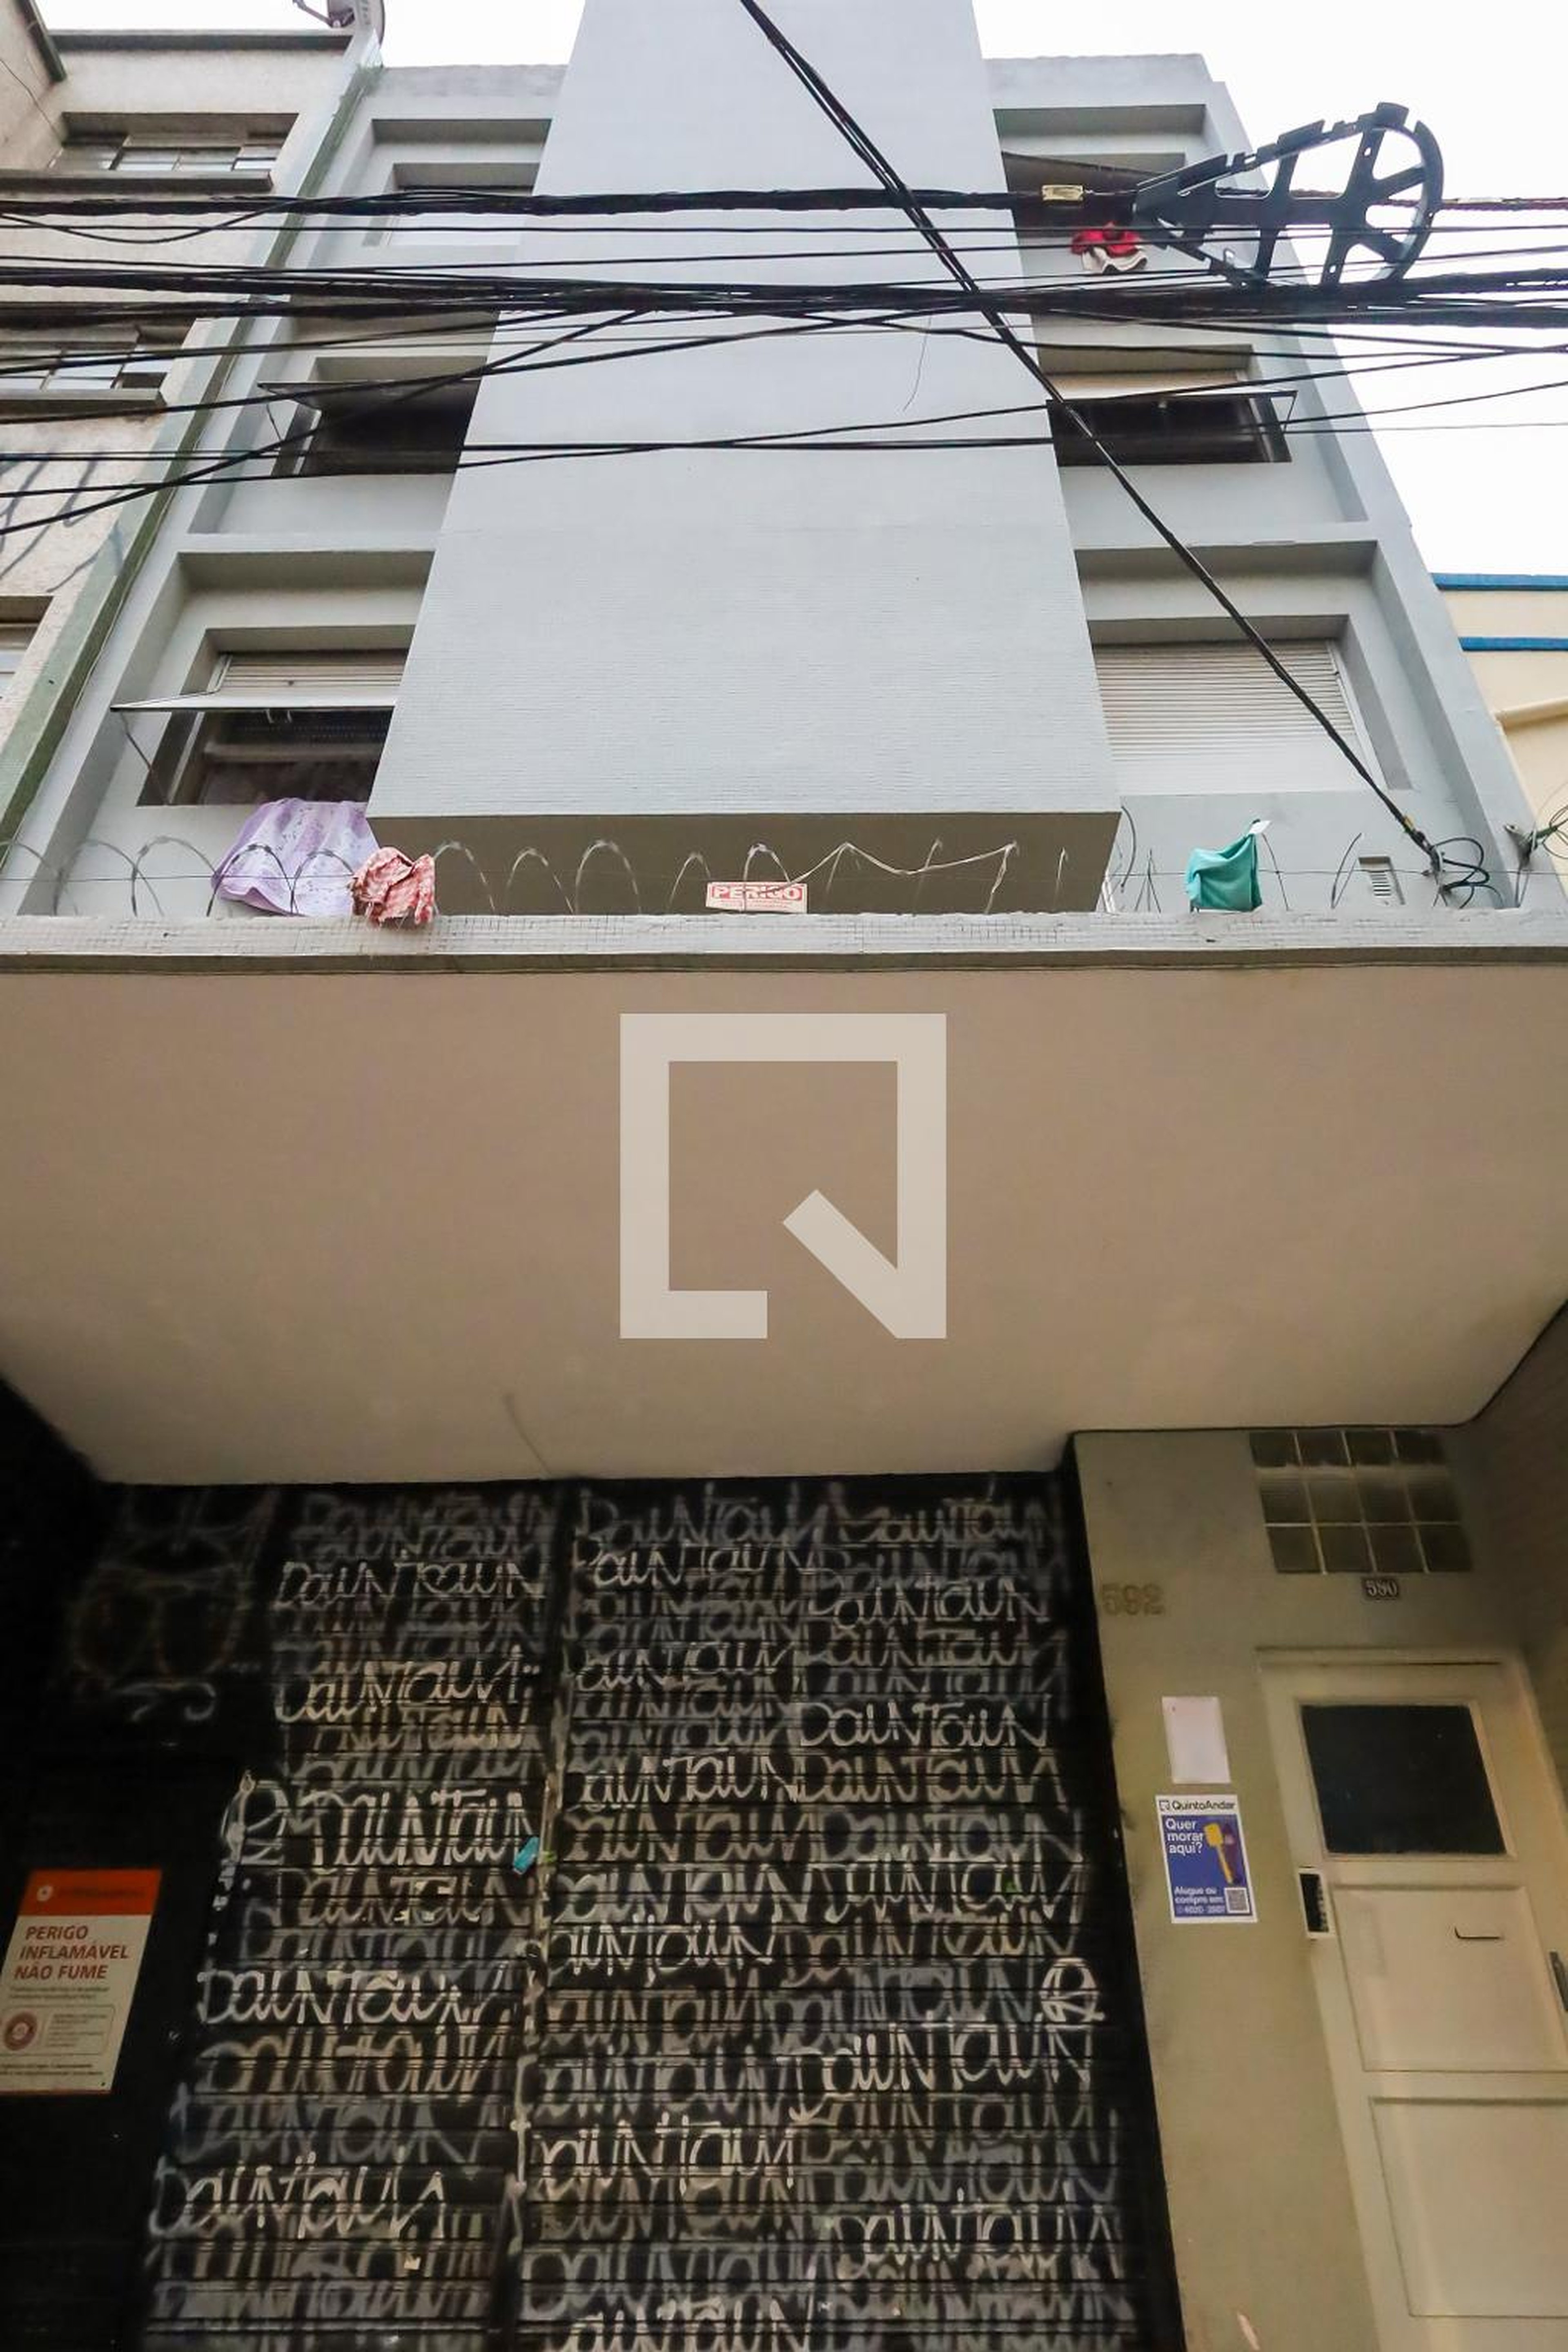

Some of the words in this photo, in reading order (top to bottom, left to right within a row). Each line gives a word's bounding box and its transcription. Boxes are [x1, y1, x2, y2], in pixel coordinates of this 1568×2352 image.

[714, 885, 802, 900] PERIGO
[1172, 1801, 1234, 1811] QuintoAndar
[1166, 1818, 1197, 1830] Quer
[1168, 1831, 1204, 1842] morar
[1169, 1842, 1203, 1856] aqui?
[26, 1926, 88, 1940] PERIGO
[20, 1941, 129, 1959] INFLAMÁVEL
[15, 1962, 52, 1979] NÃO
[58, 1965, 108, 1979] FUME
